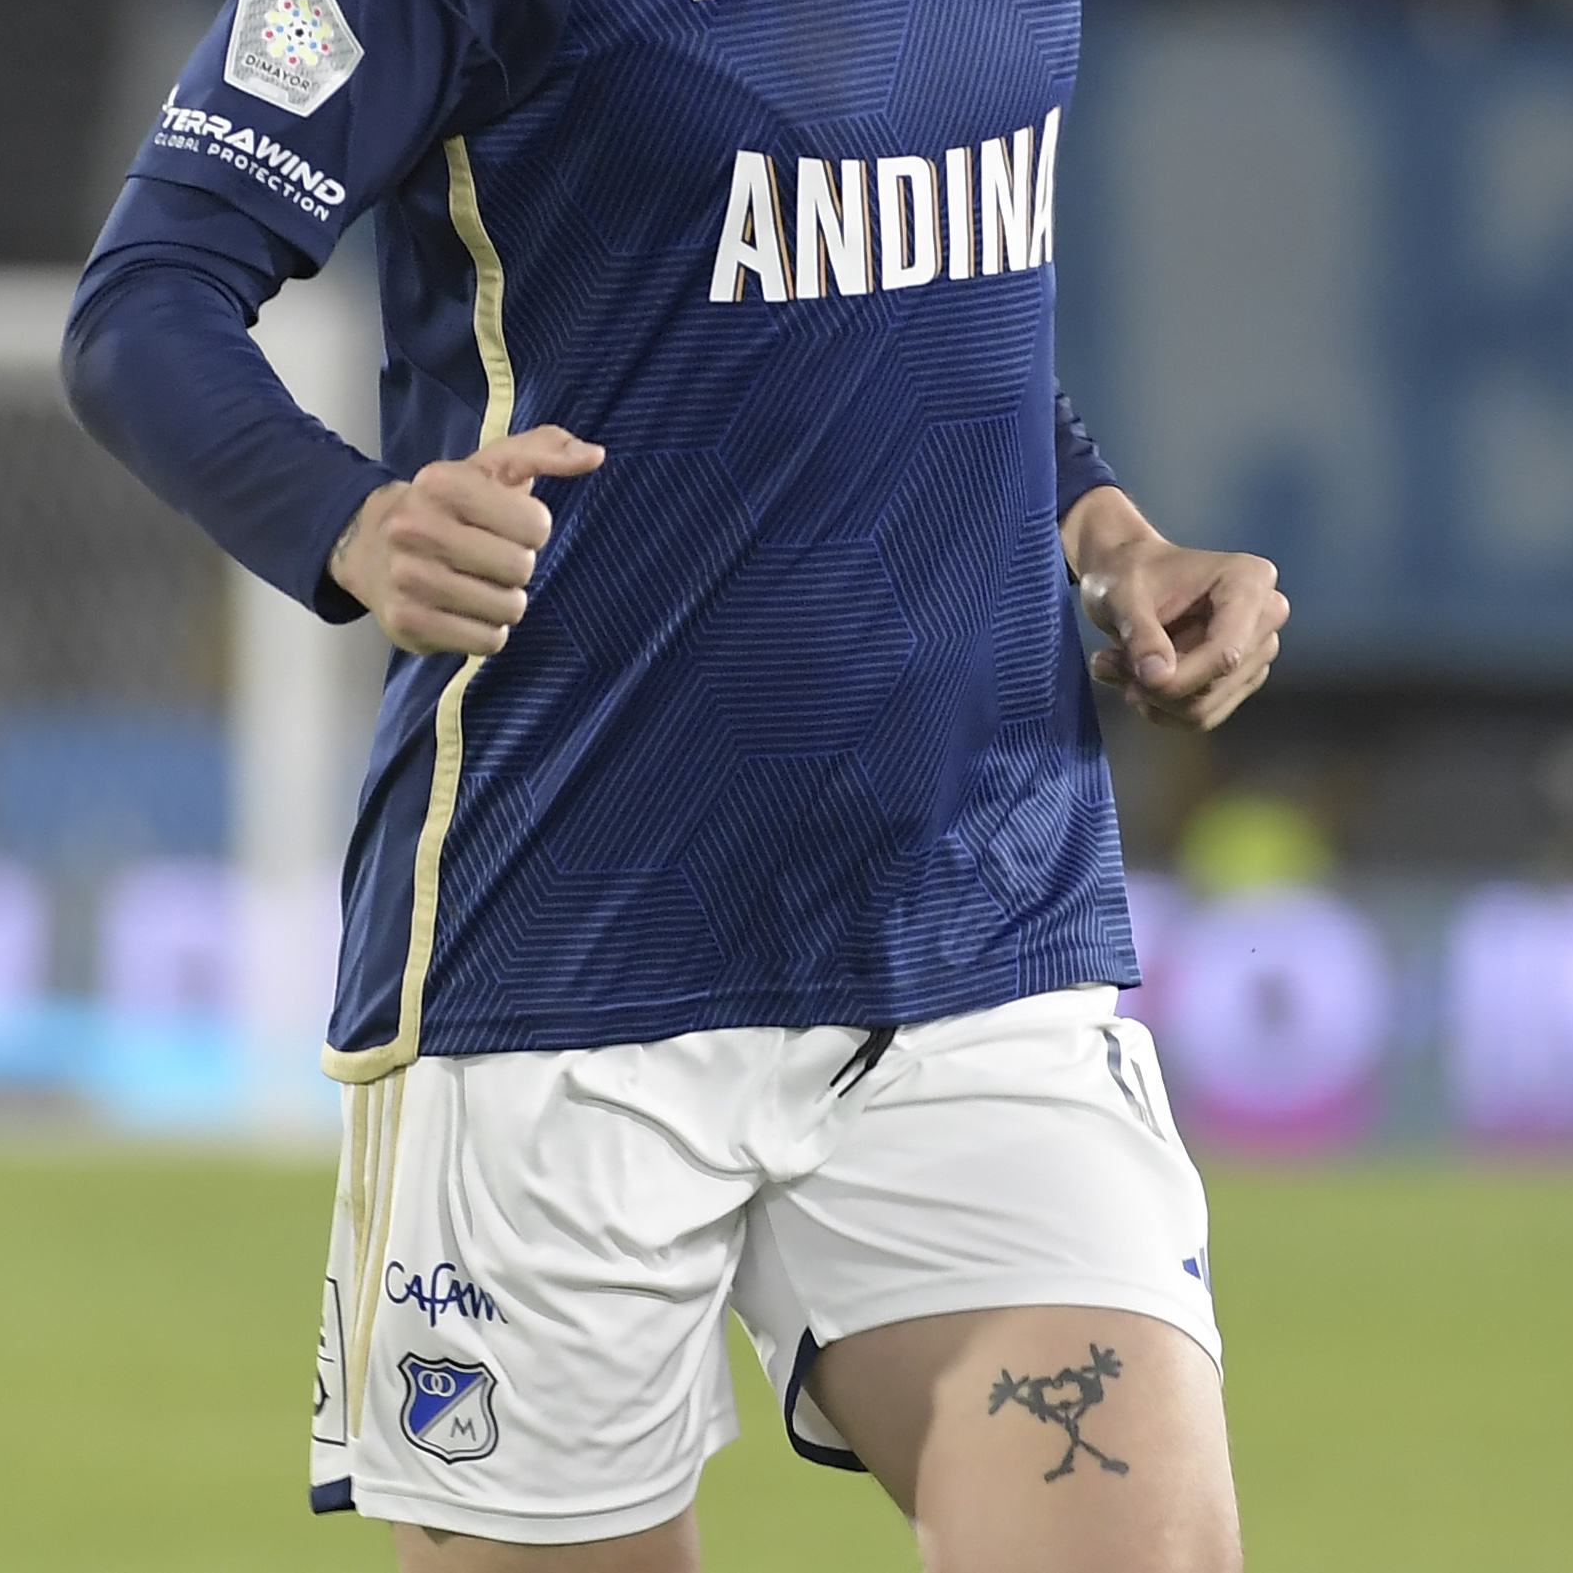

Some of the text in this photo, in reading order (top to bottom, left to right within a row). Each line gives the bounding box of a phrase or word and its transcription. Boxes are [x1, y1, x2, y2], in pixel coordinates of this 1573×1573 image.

[245, 54, 312, 92] DIMAYOR
[154, 131, 331, 222] GLOBAL PROTECTION
[161, 106, 346, 206] TERRAWIND
[708, 105, 1061, 303] ANDINA
